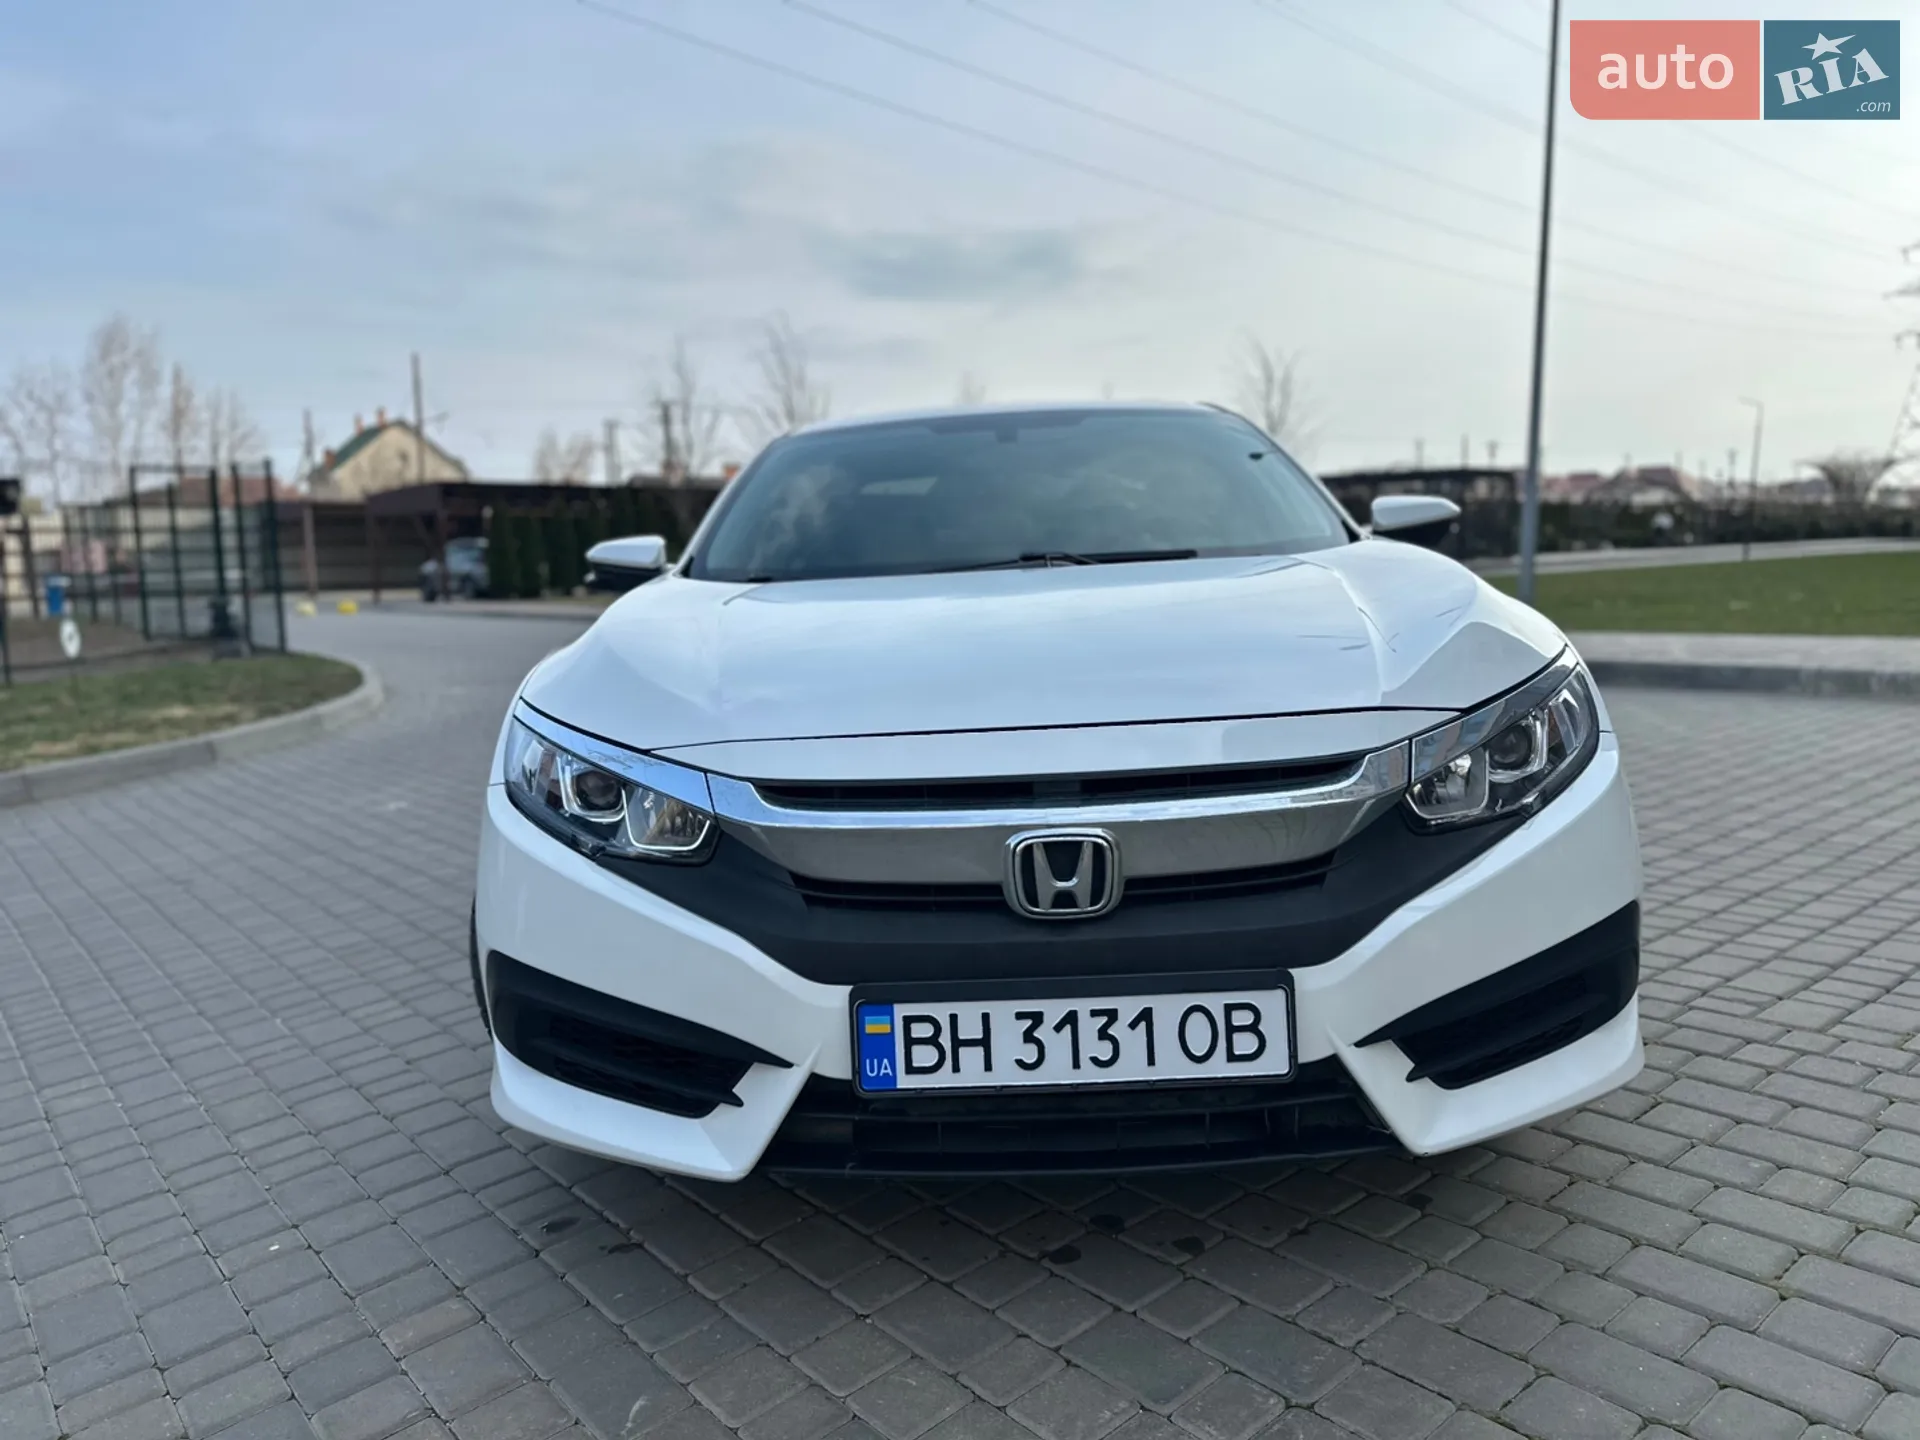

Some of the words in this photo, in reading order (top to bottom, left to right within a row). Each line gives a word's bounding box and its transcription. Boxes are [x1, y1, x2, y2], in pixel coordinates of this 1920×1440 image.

[902, 1012, 993, 1075] BH
[1014, 1006, 1157, 1071] 3131
[1178, 1002, 1267, 1064] OB
[865, 1058, 893, 1078] UA
